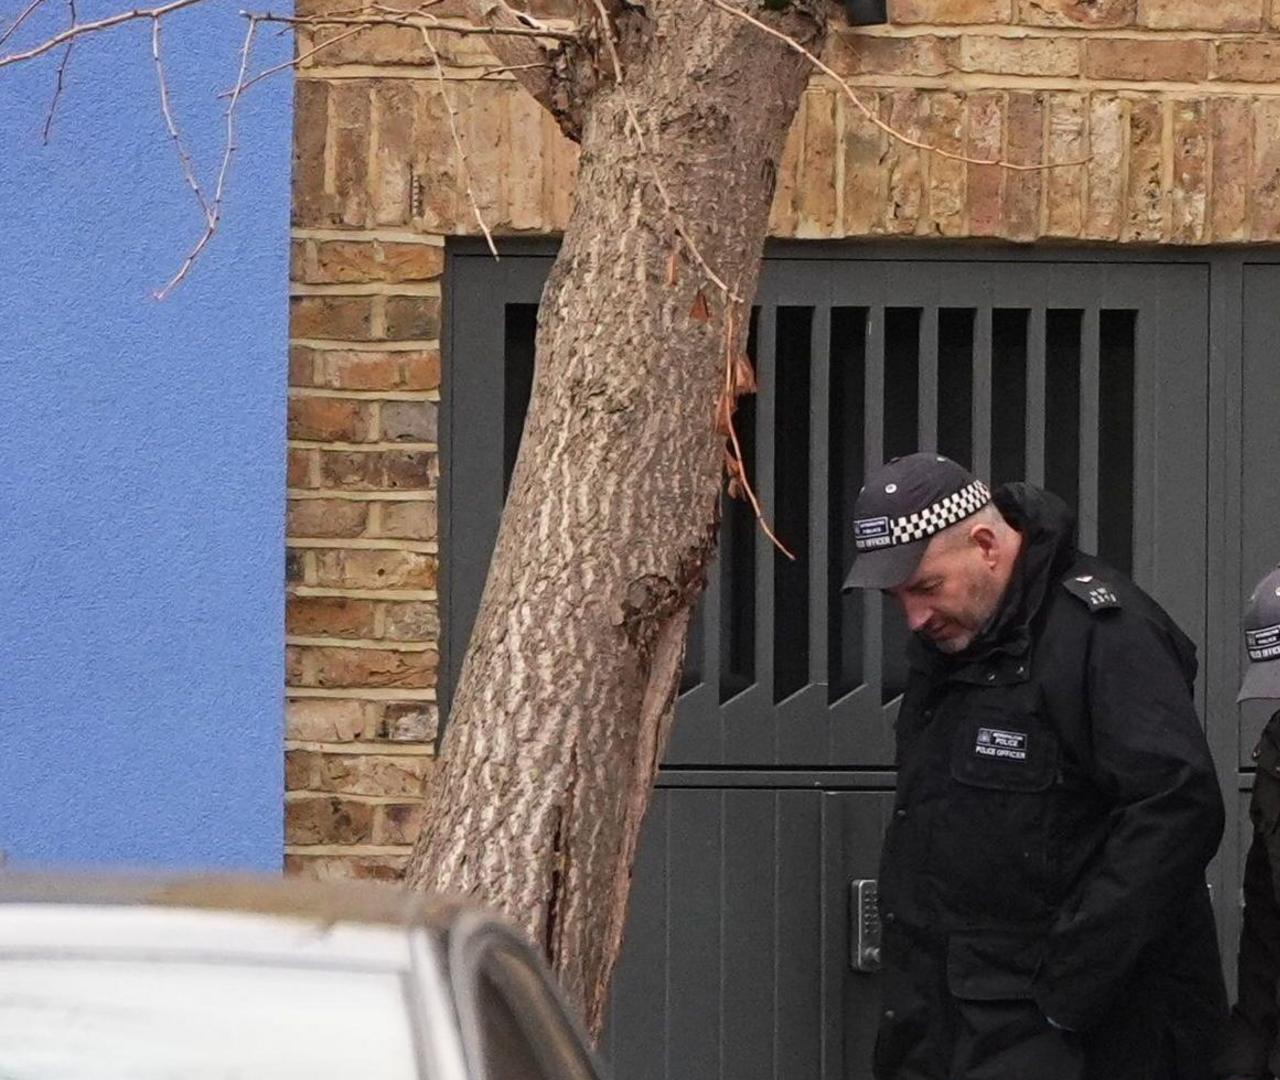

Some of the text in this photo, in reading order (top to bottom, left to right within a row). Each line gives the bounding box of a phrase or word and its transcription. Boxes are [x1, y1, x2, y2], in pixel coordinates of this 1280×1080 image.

[866, 536, 890, 548] OFFICER
[995, 738, 1019, 748] POLICE
[976, 745, 1026, 759] POLICE OFFICER
